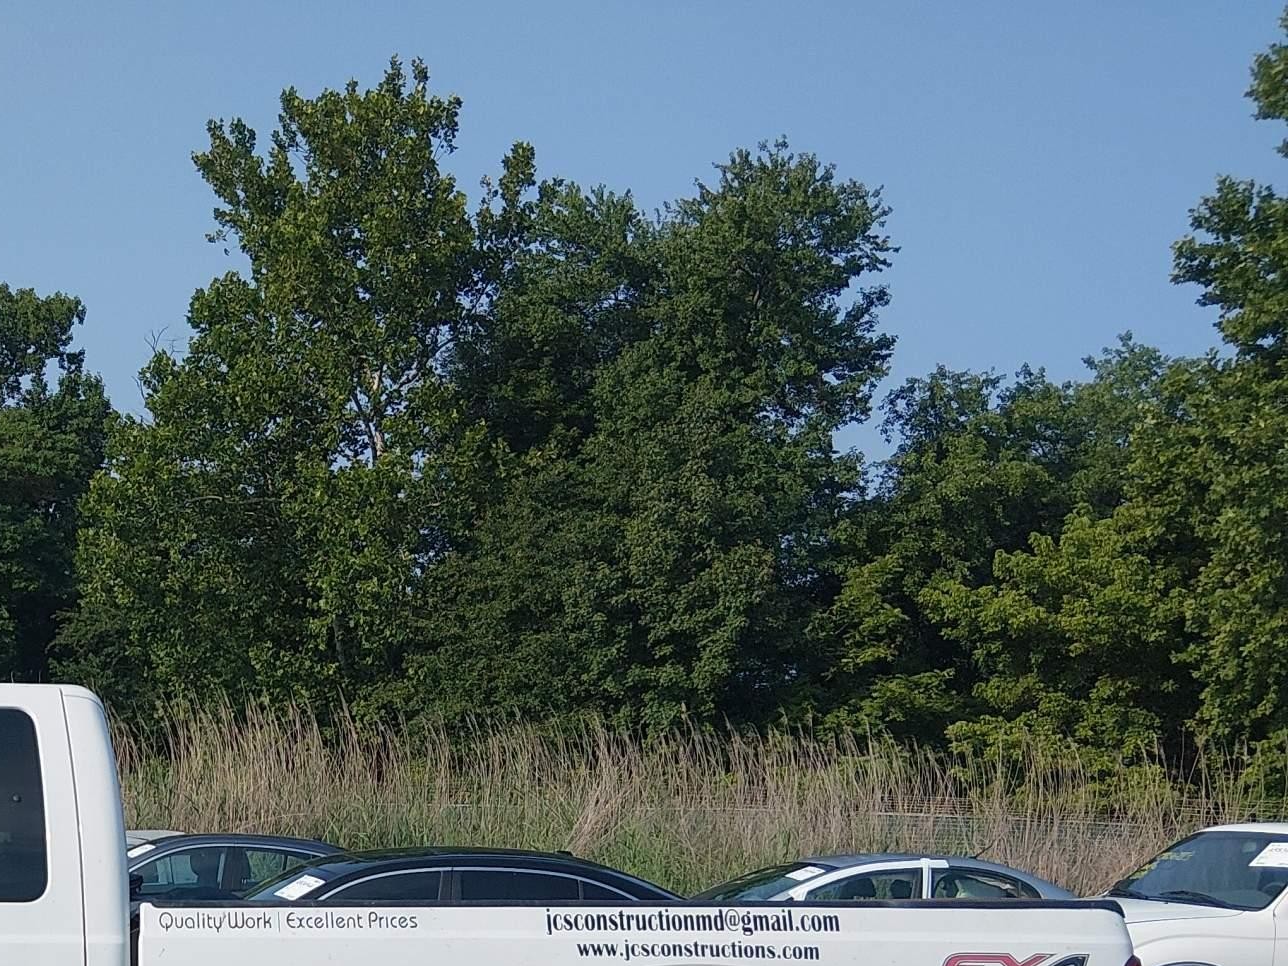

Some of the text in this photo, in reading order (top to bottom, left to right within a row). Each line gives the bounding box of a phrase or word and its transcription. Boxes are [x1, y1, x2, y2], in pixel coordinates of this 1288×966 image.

[159, 912, 224, 932] Quality
[227, 912, 272, 928] Work
[286, 912, 363, 928] Excellent
[368, 911, 418, 928] Prices
[546, 908, 840, 936] jcsconstructionmd@gmail.com
[577, 940, 820, 960] www.jcsconstructions.com
